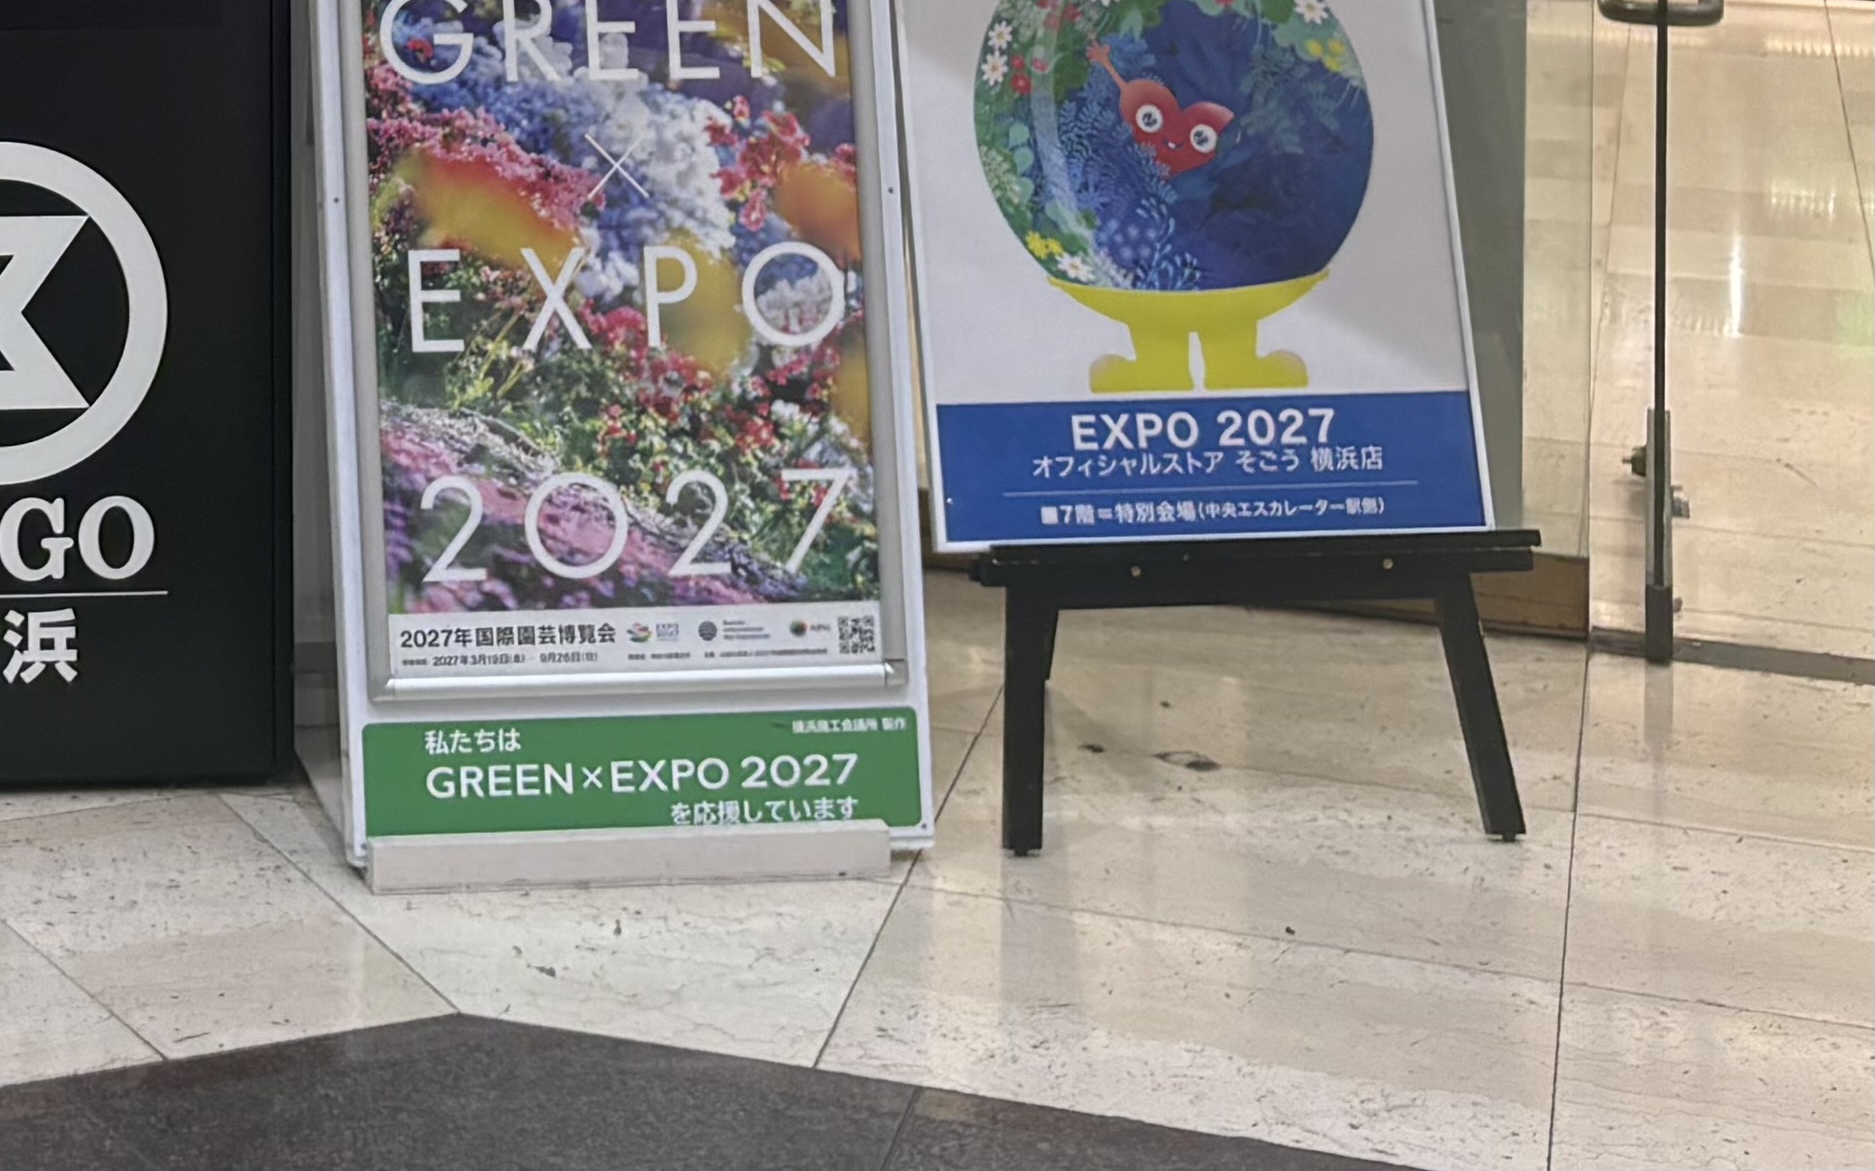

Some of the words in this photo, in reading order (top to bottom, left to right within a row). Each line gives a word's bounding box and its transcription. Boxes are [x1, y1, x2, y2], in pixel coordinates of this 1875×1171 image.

[406, 241, 845, 355] EXPO
[1071, 411, 1198, 452] EXPO
[1217, 408, 1337, 447] 2027
[1032, 449, 1225, 479] オフィシャルストア
[1234, 448, 1300, 472] そごう
[1310, 445, 1384, 472] 横浜店
[0, 495, 155, 581] GO
[420, 467, 858, 583] 2027
[2, 607, 78, 685] 浜
[399, 623, 616, 649] 2027年国際園芸博覧会
[424, 728, 521, 755] 私たちは
[741, 753, 860, 789] 2027
[670, 796, 859, 824] を応援しています
